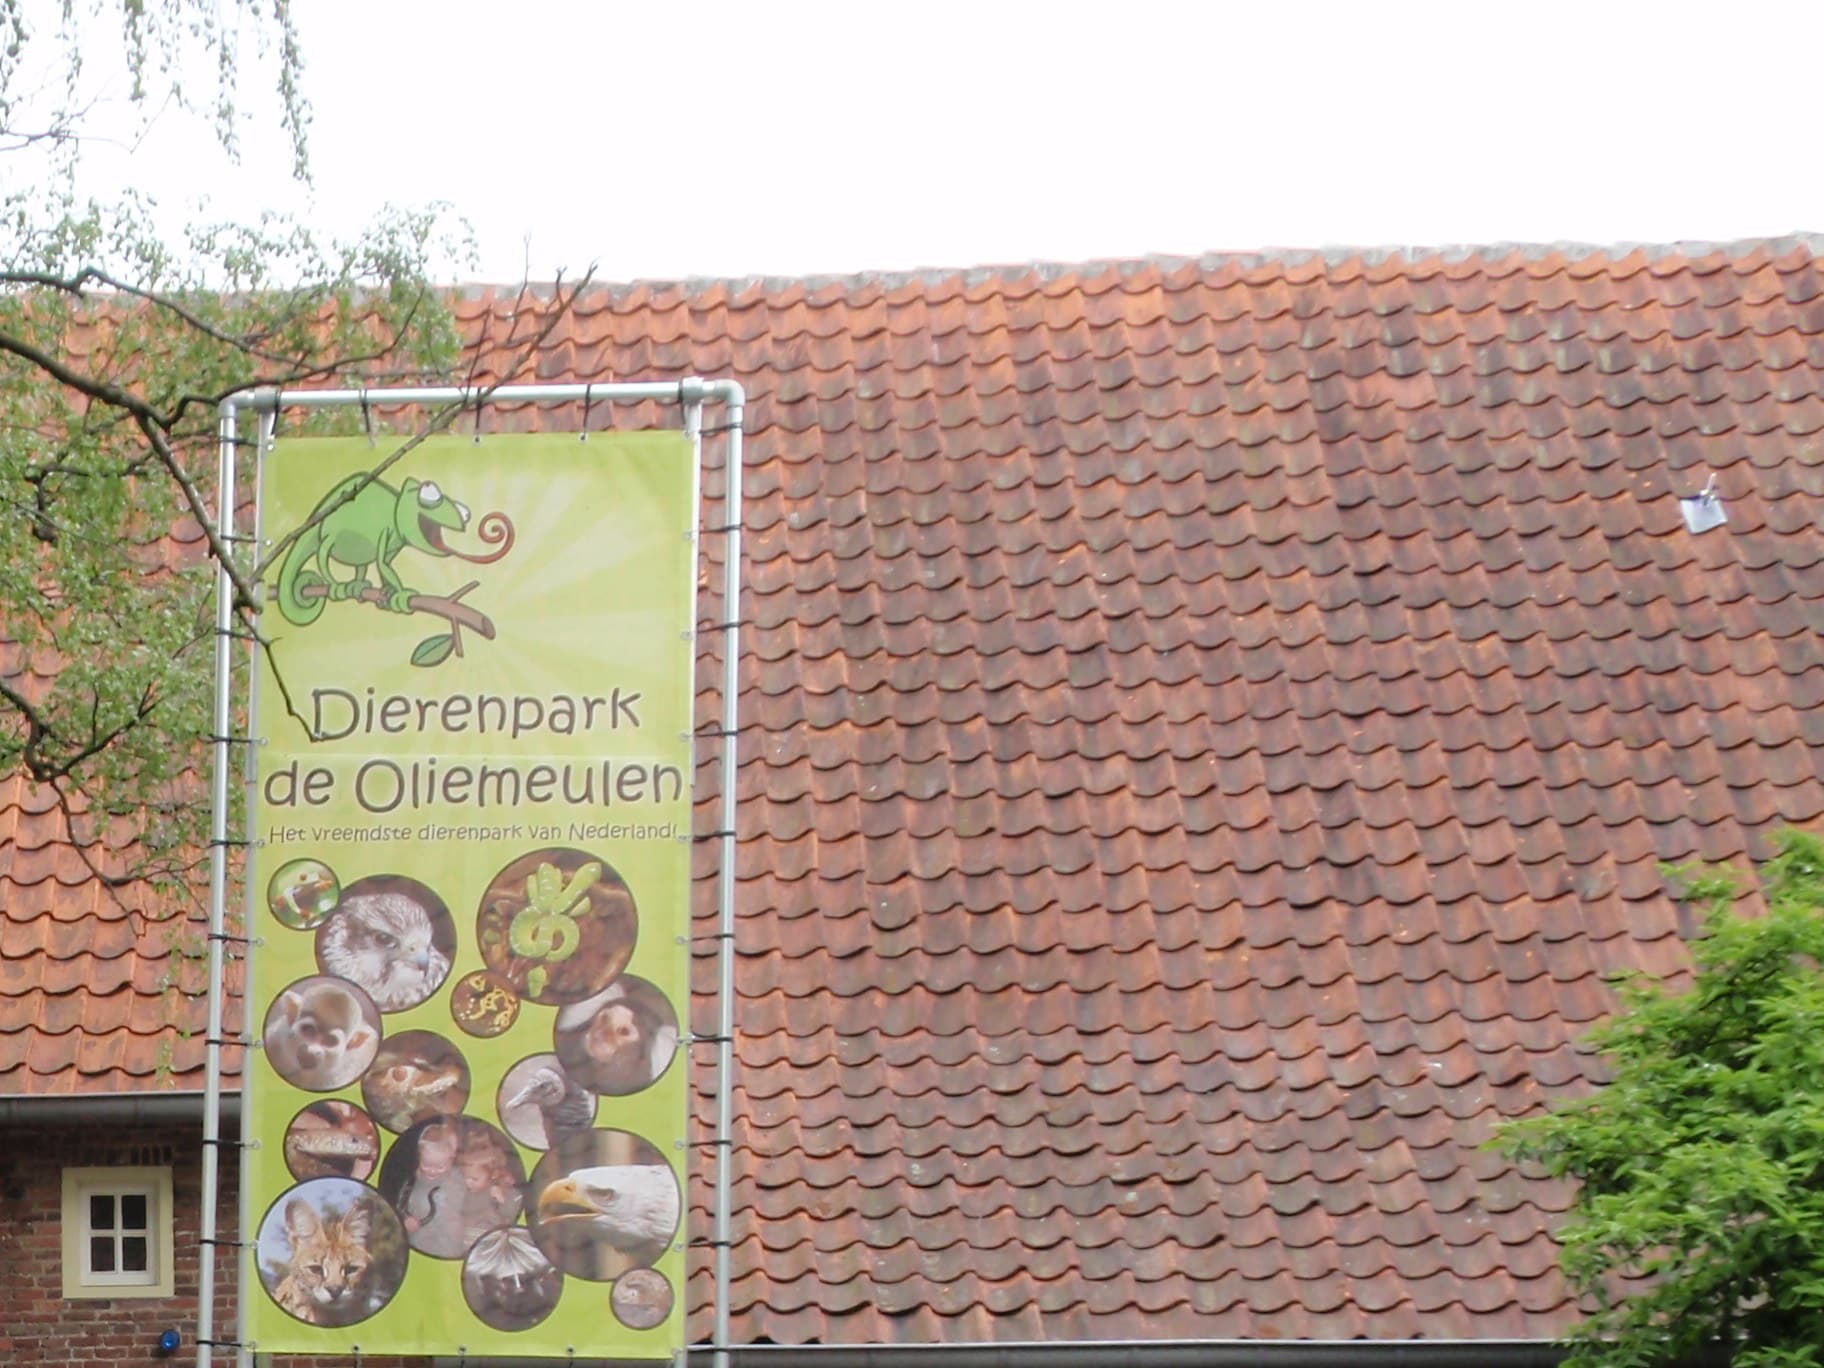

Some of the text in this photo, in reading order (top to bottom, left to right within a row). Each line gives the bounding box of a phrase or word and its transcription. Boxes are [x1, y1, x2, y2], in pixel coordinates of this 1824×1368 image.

[312, 687, 642, 740] Dierenpark
[264, 757, 683, 813] de Oliemeulen
[270, 823, 677, 844] Het vreemdste dierenpark van Nederland!
